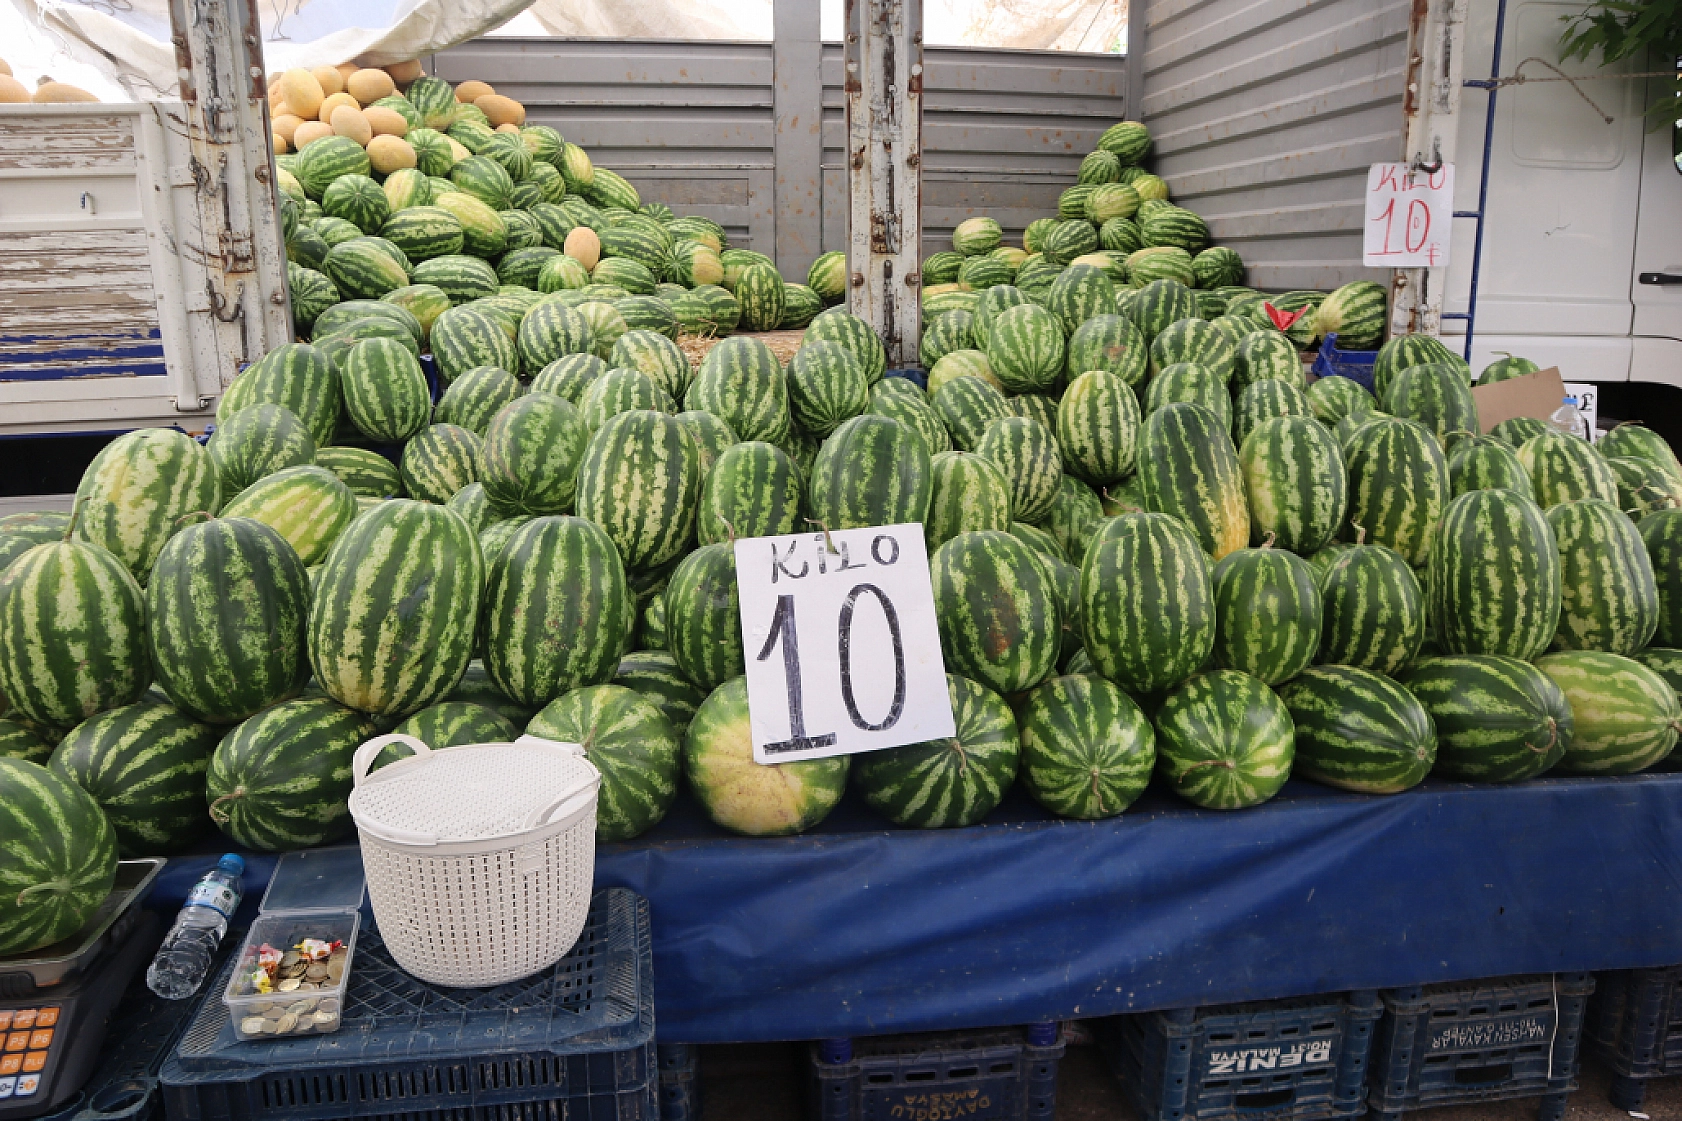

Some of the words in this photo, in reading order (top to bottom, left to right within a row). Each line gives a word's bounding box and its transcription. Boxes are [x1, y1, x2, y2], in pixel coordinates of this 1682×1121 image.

[756, 582, 906, 755] 10
[10, 1036, 26, 1046] P5
[33, 1034, 50, 1044] P6
[1211, 1047, 1281, 1061] MALATYA
